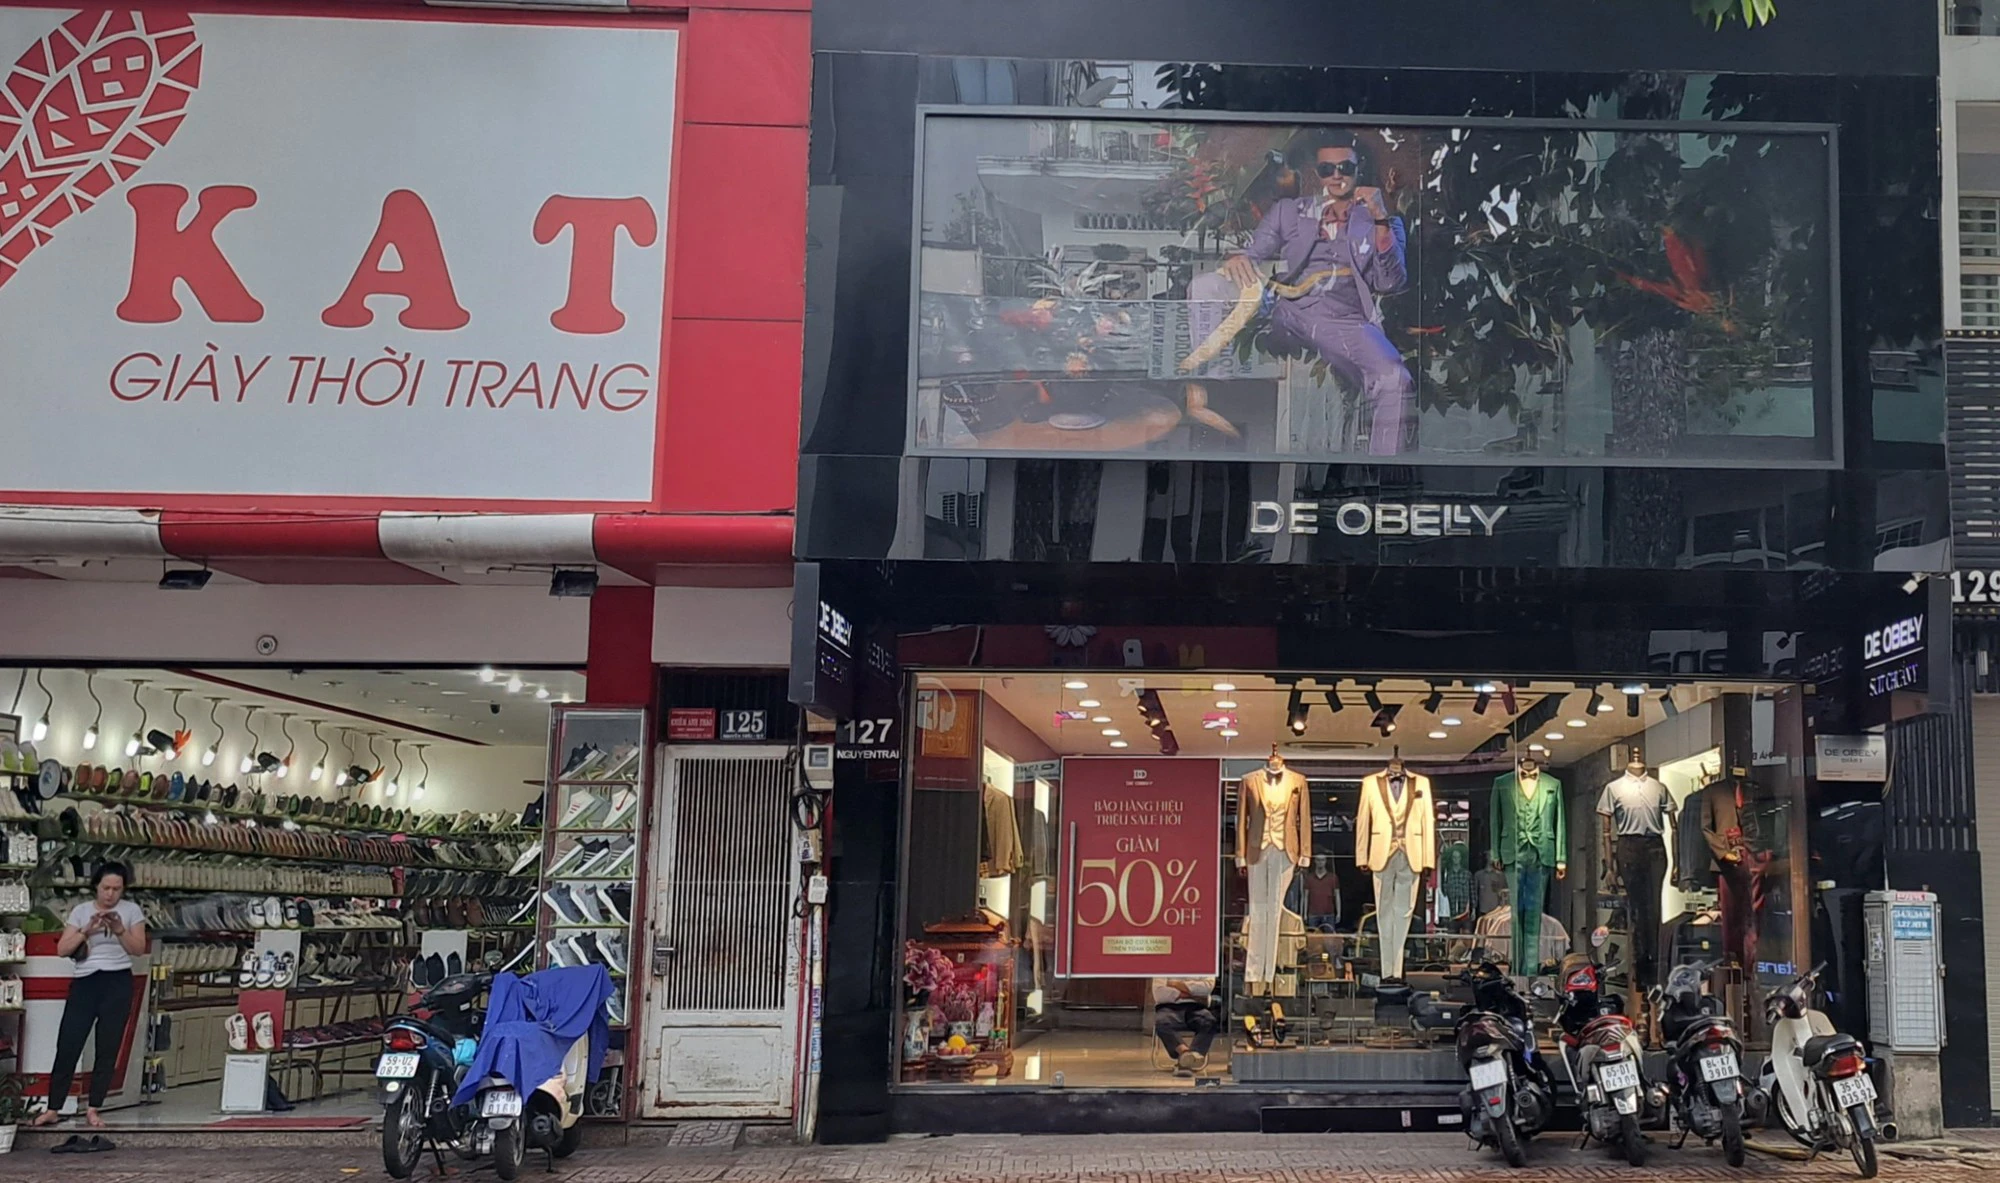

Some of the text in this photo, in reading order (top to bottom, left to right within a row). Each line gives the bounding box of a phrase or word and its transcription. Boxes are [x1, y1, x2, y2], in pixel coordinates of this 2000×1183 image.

[116, 183, 658, 335] KAT
[109, 341, 651, 412] GIÀY THỜI TRANG
[1250, 501, 1508, 537] DE OBELLY
[1864, 630, 1881, 660] DE
[726, 711, 764, 733] 125
[844, 718, 893, 744] 127
[1130, 814, 1157, 826] SALE
[1077, 857, 1200, 927] 50%
[1163, 907, 1201, 926] OFF
